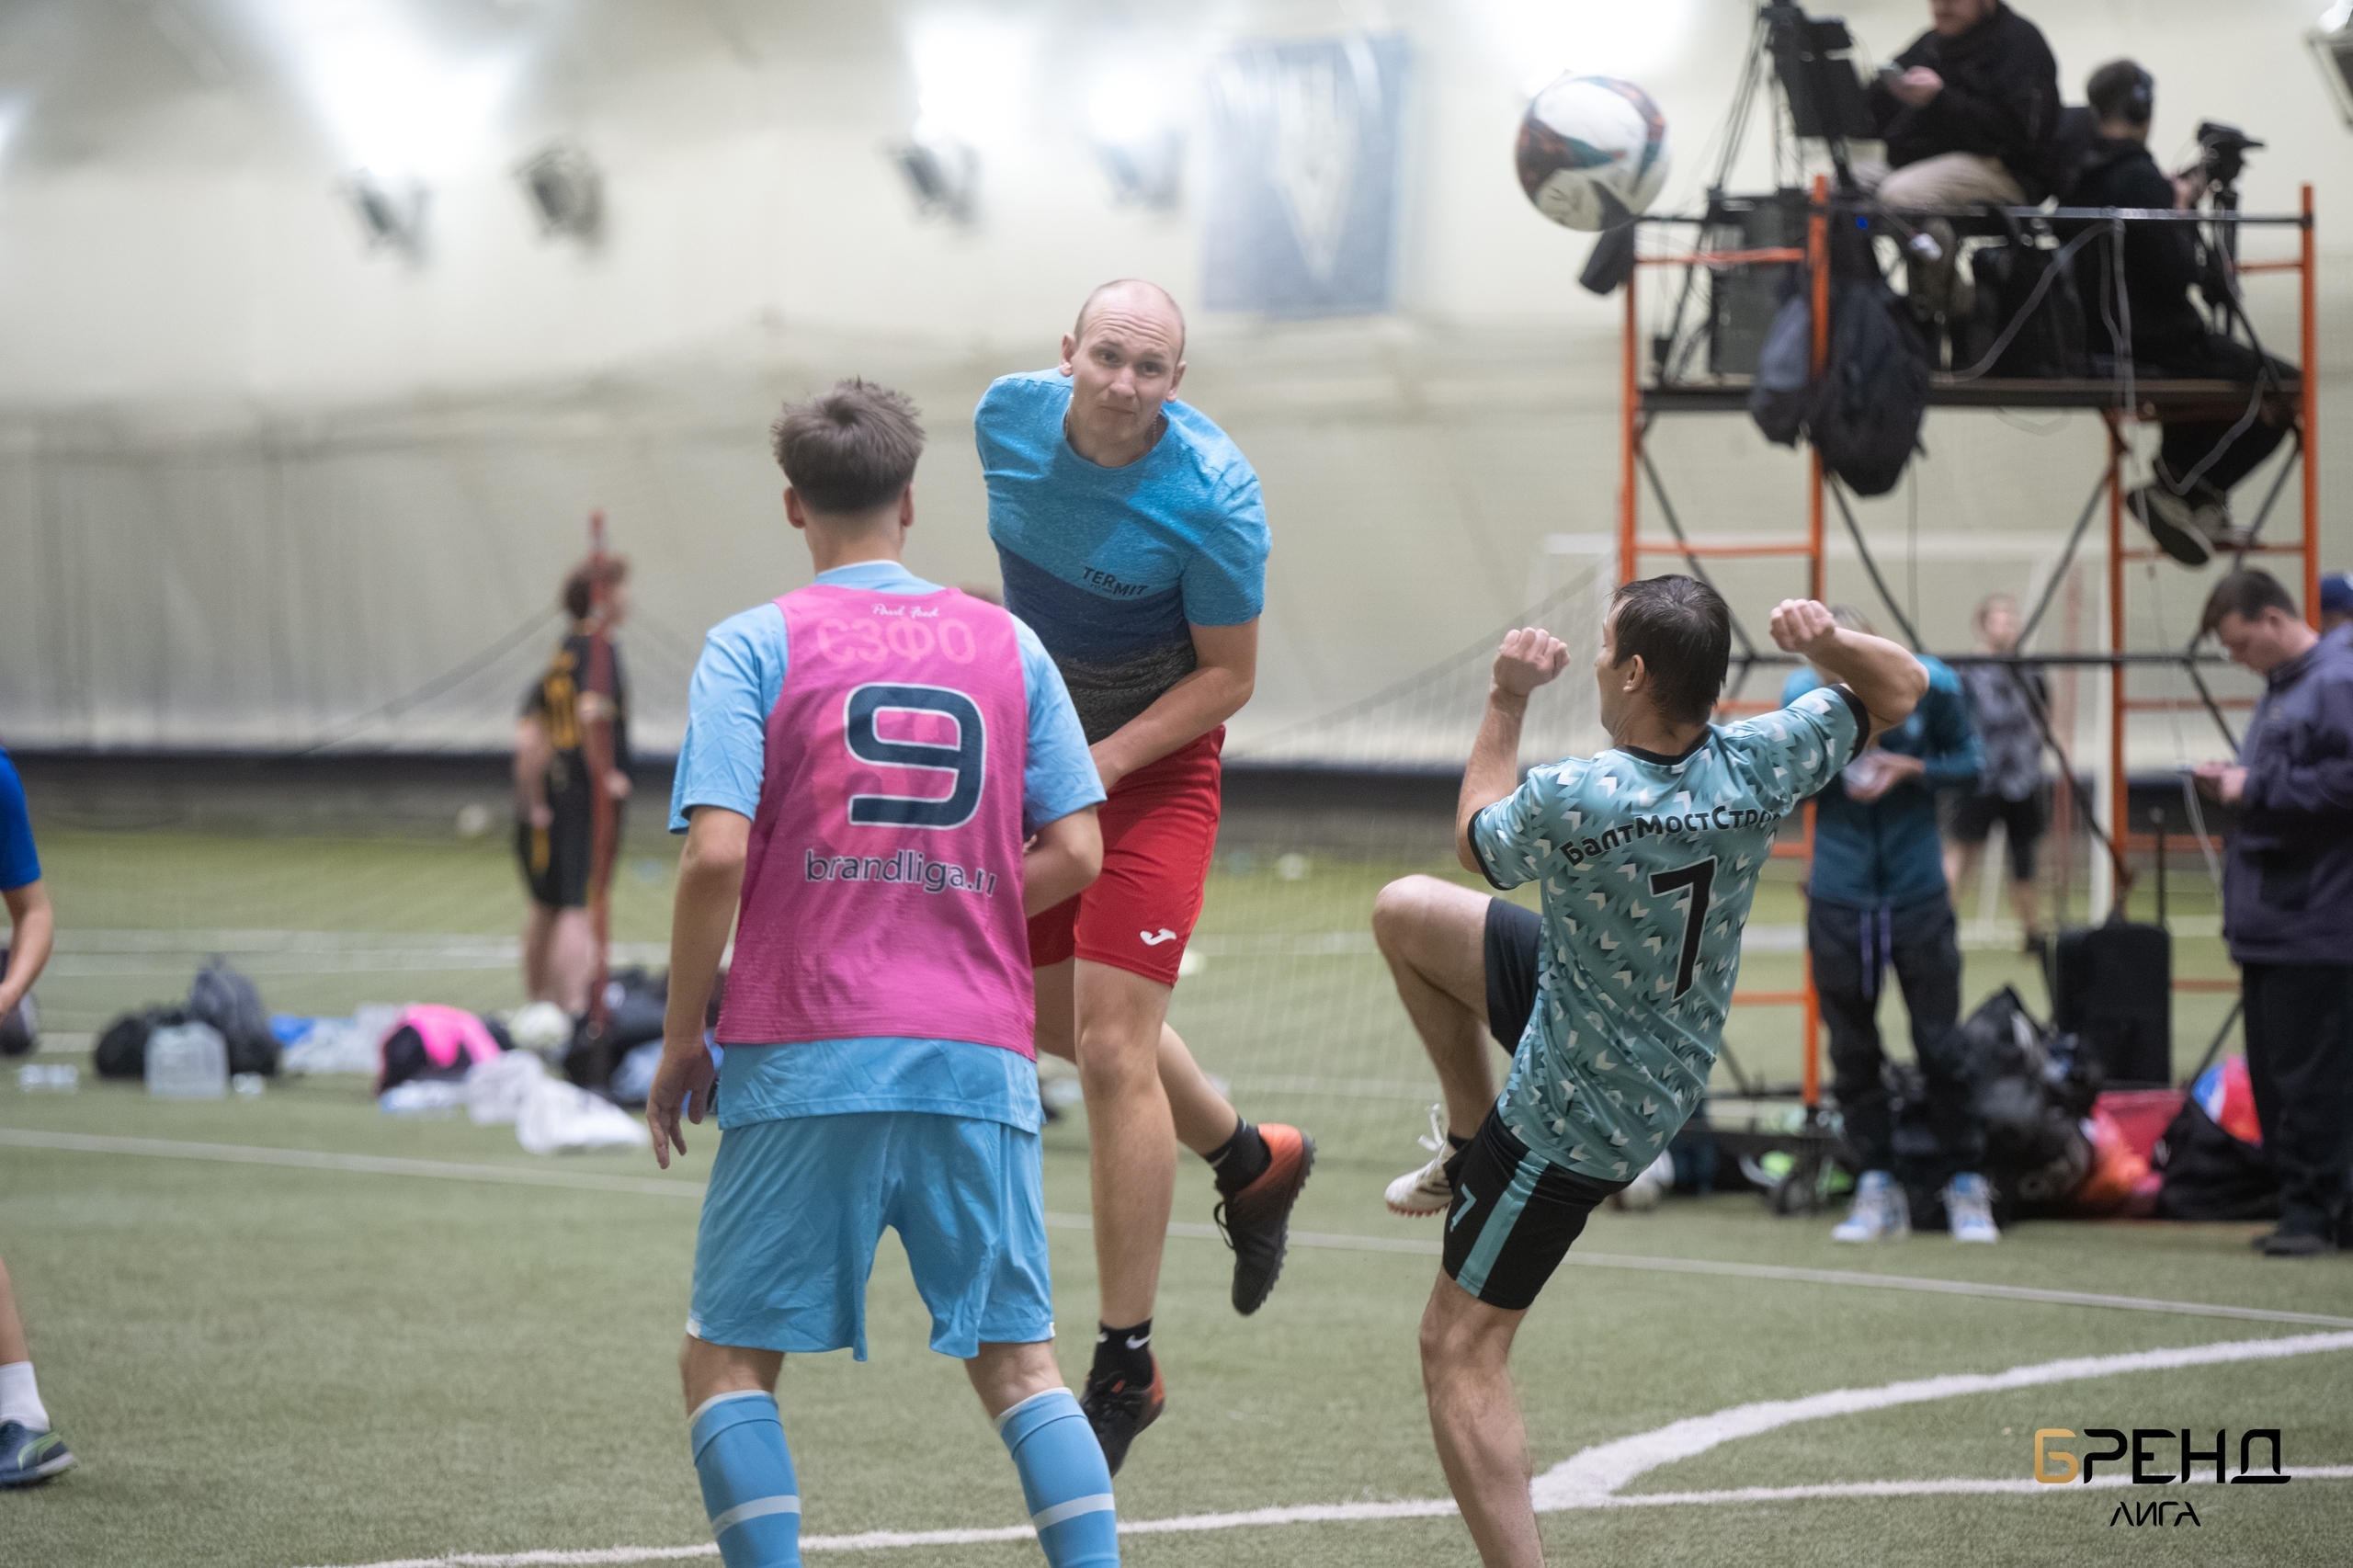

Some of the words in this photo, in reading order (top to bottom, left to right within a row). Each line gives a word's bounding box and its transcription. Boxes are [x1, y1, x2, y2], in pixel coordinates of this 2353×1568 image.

[1083, 566, 1149, 596] TERMIT
[843, 681, 986, 830] 9
[1648, 855, 1718, 1003] 7
